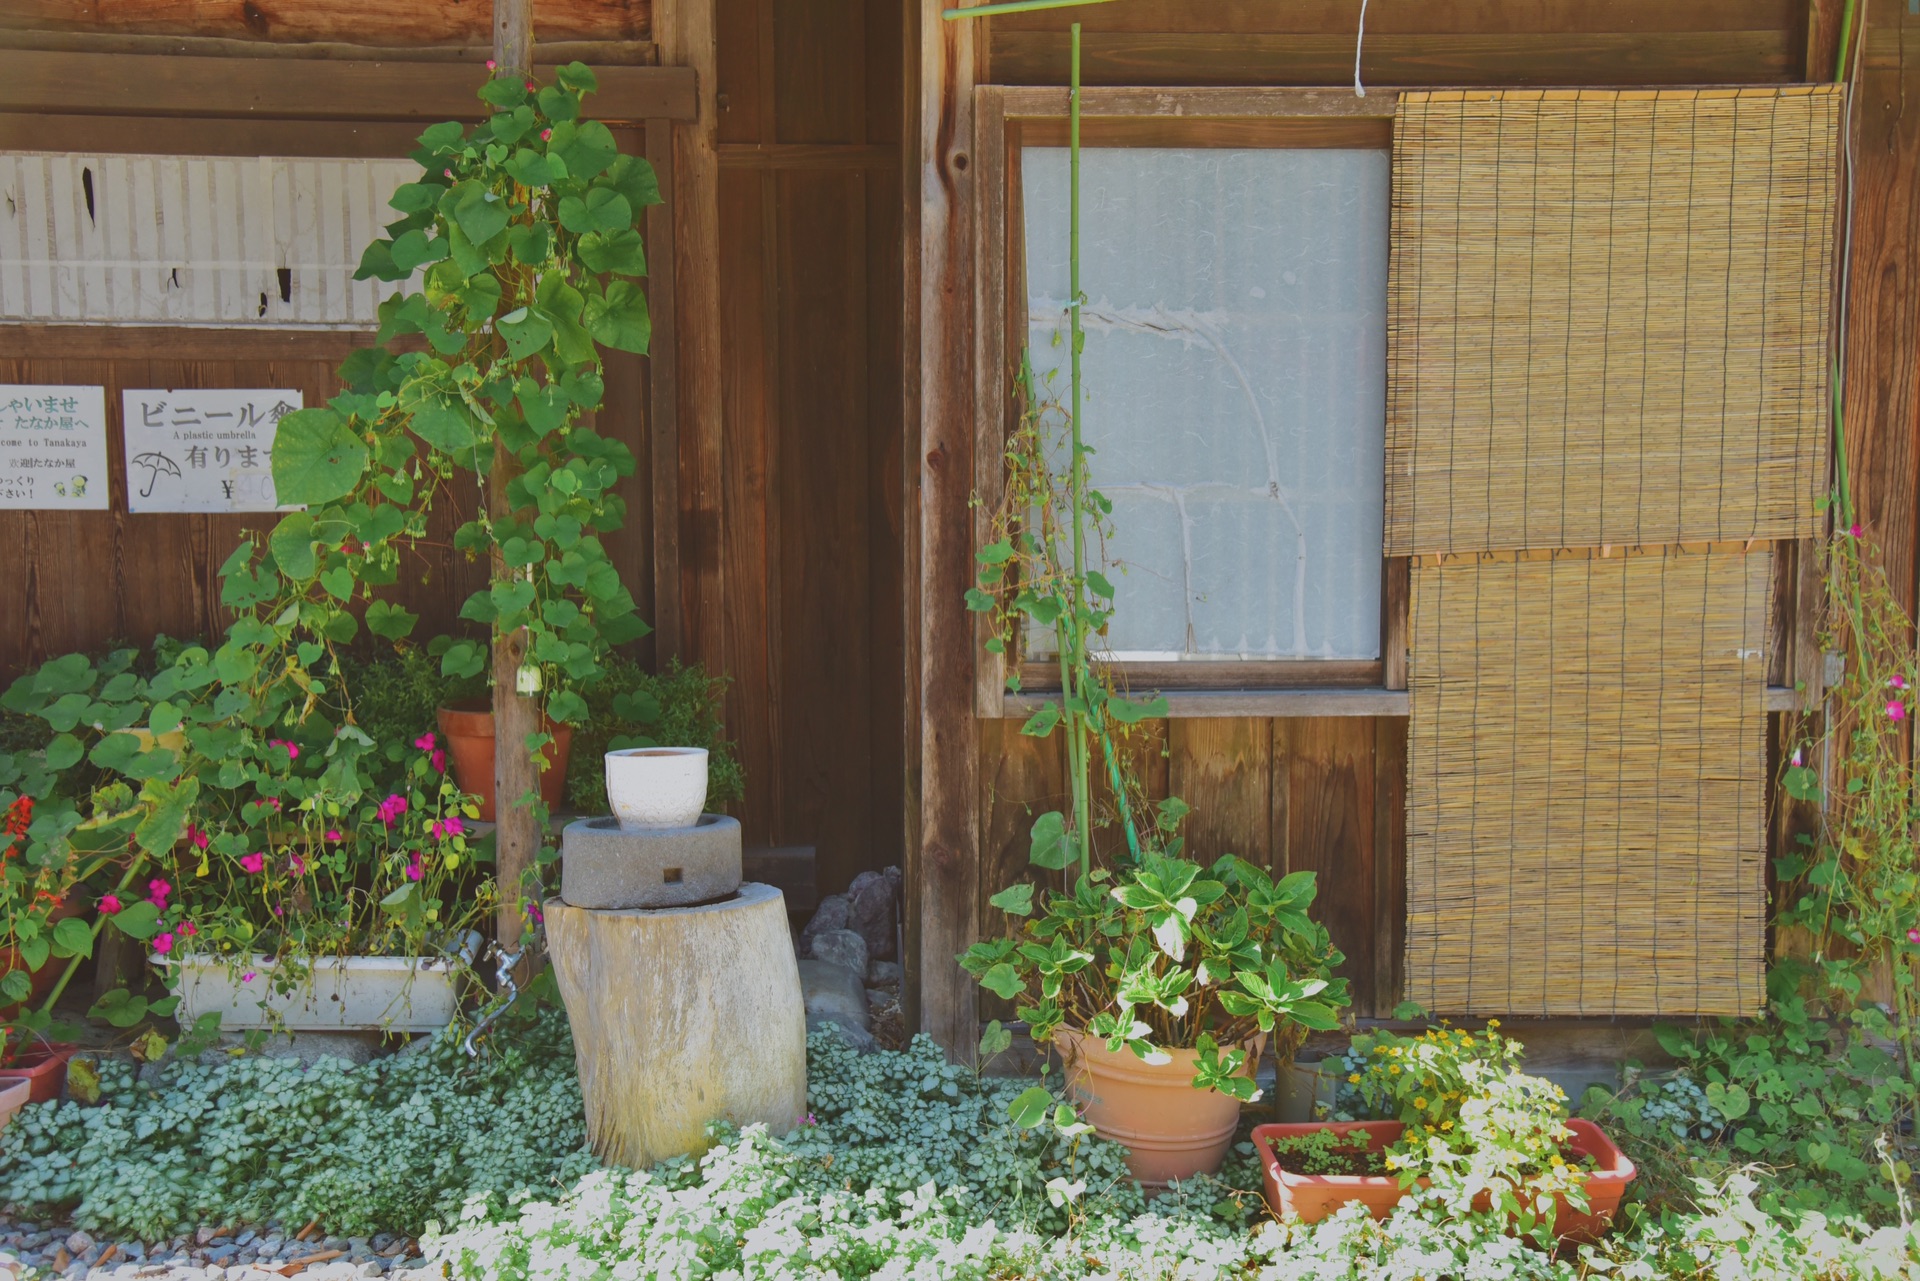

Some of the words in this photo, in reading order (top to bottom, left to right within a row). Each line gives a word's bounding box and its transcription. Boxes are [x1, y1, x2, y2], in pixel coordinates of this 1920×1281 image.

[15, 416, 89, 430] たなか屋へ
[173, 431, 180, 440] A
[183, 431, 214, 441] plastic
[217, 431, 256, 440] umbrella
[29, 438, 38, 447] to
[44, 438, 87, 448] Tanakaya
